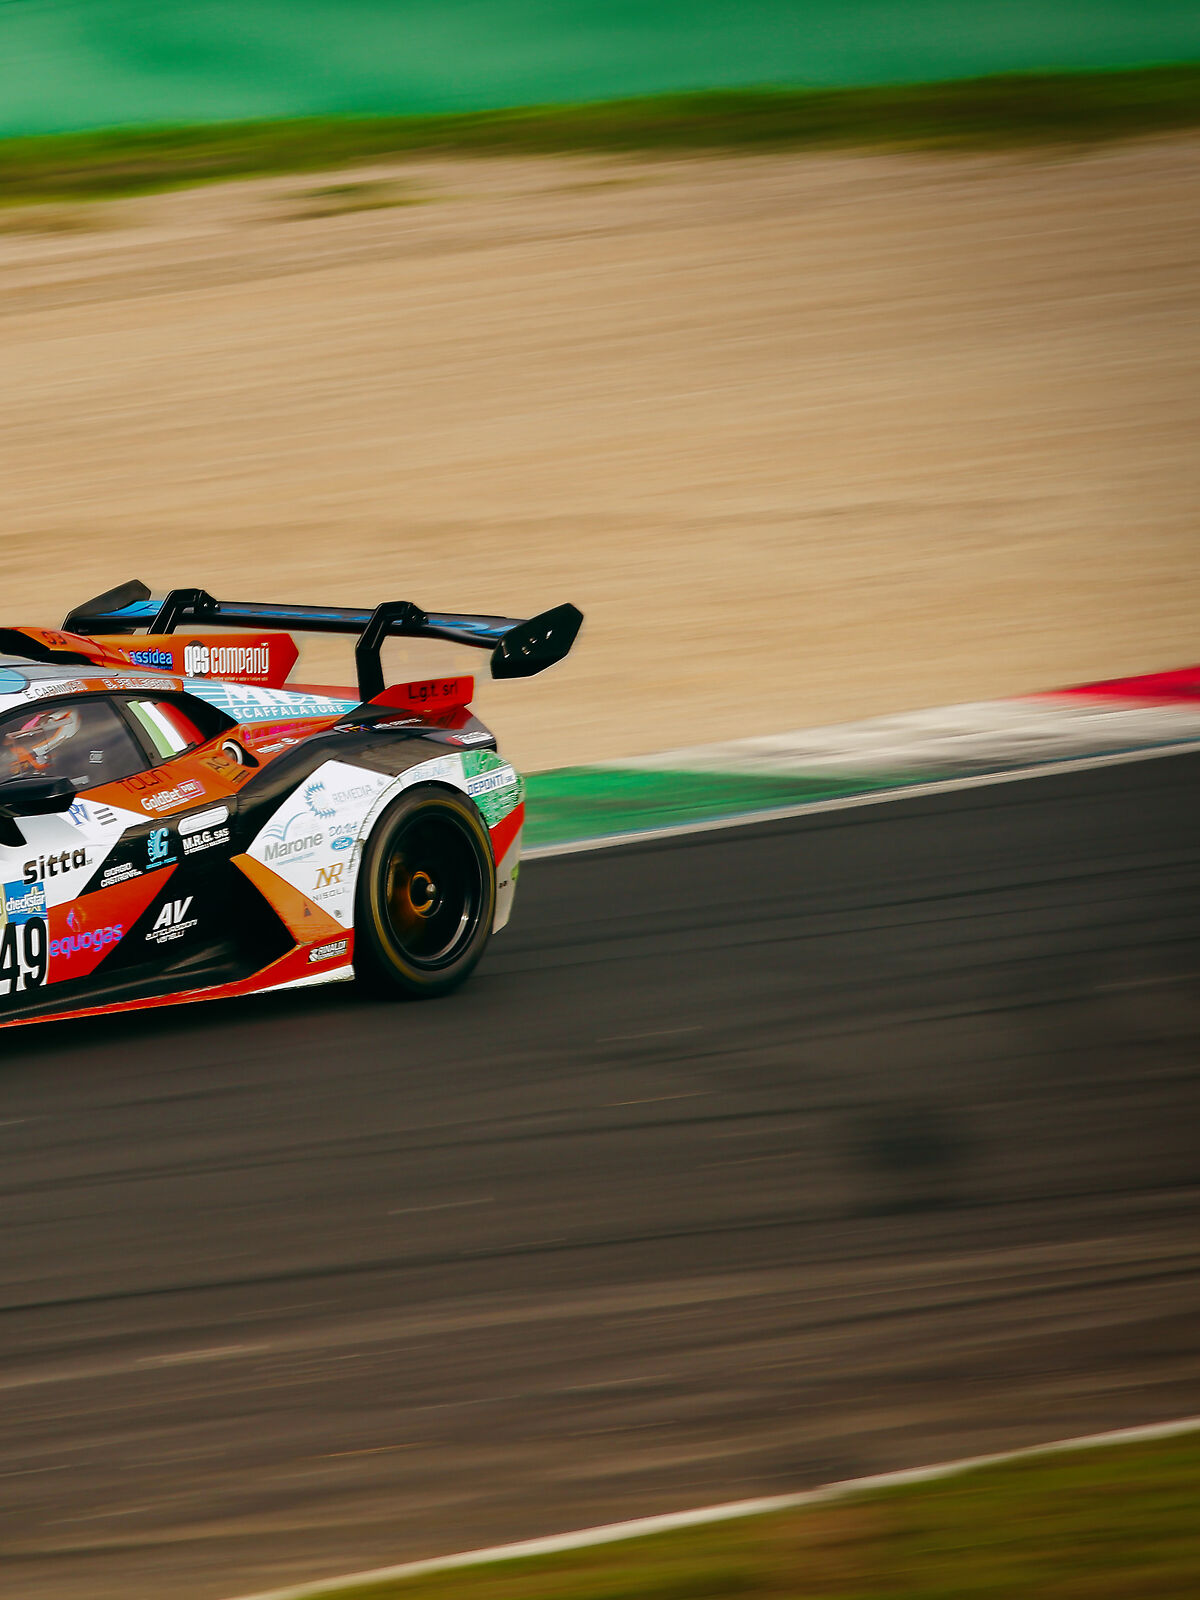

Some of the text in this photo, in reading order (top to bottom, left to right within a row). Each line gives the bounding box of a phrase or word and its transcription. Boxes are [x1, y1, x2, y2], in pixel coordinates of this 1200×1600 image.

[232, 704, 346, 719] SCAFFALATURE
[467, 775, 503, 796] DEPONTI
[141, 787, 181, 810] GoldBet
[264, 833, 324, 861] Marone
[153, 896, 194, 930] AV
[50, 924, 123, 960] equogas
